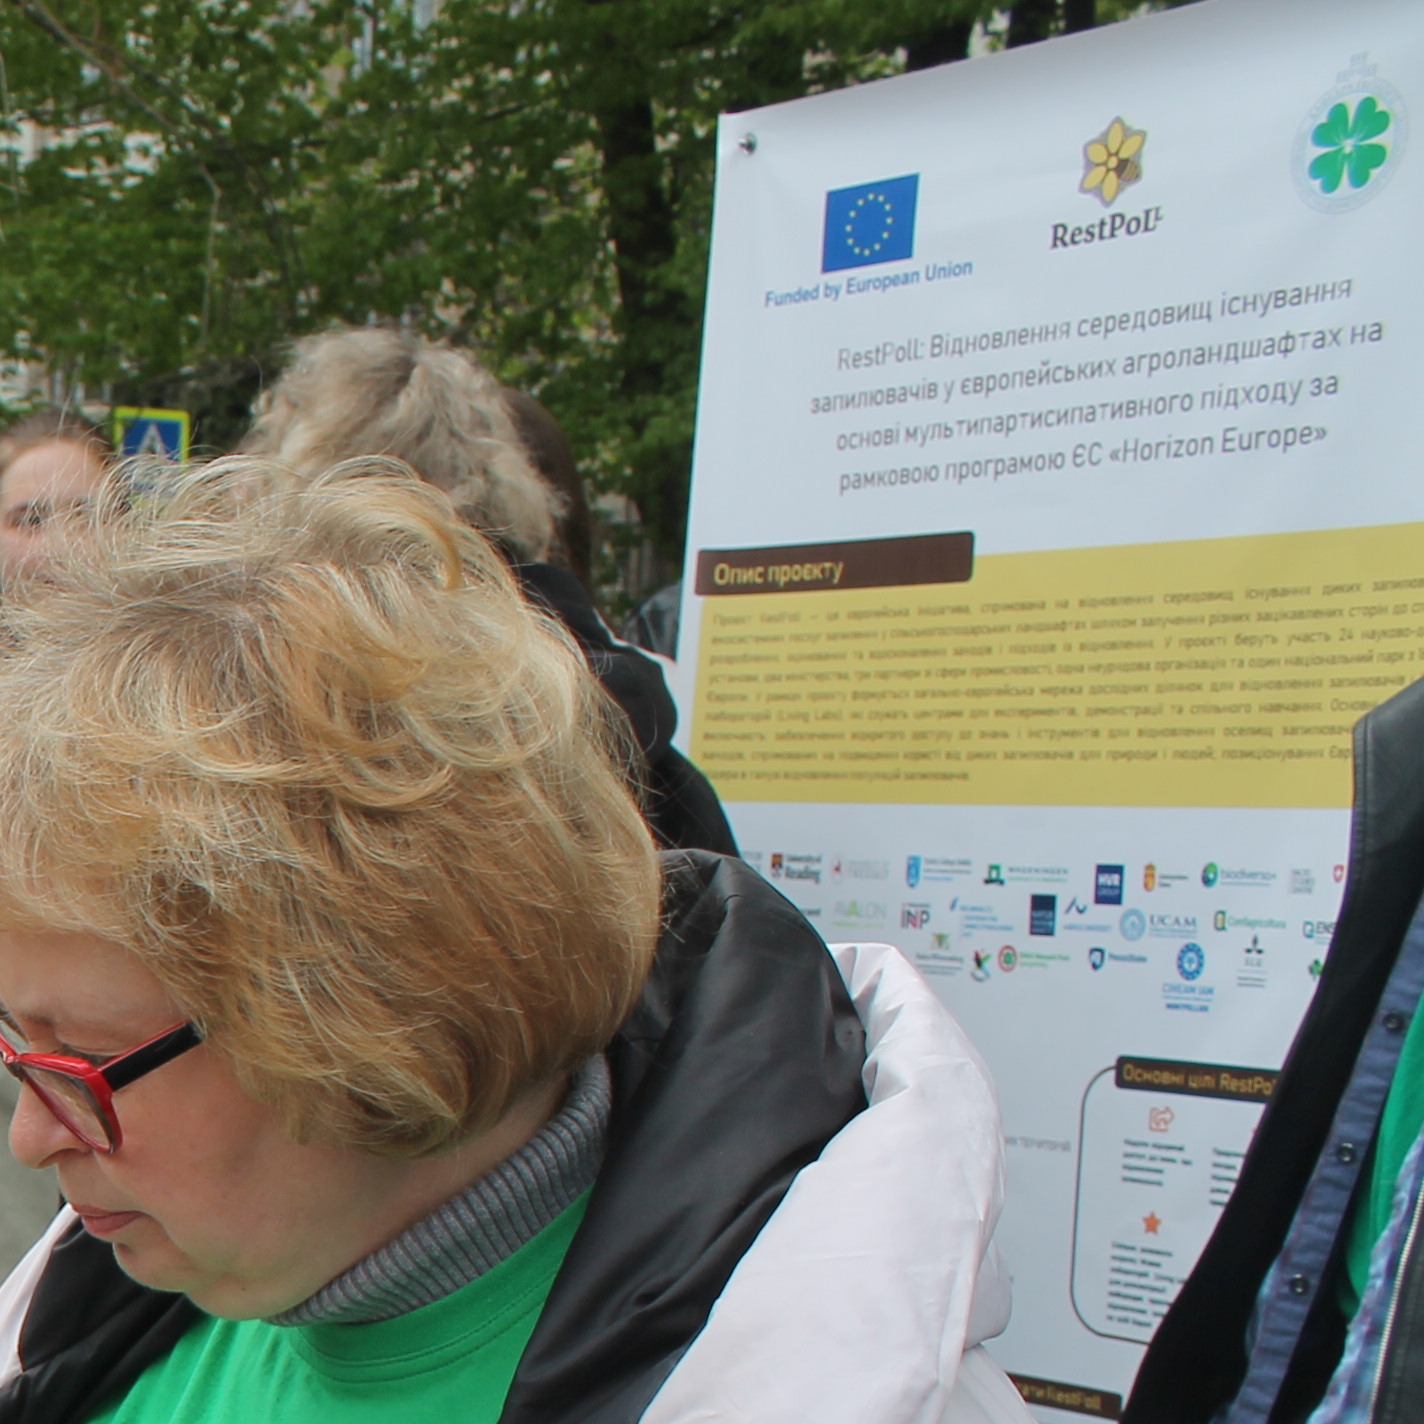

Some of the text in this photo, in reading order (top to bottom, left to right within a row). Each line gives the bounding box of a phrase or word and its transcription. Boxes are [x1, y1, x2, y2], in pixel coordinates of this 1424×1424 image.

[764, 261, 973, 308] Funded by European Union
[837, 278, 1353, 371] RestPoll: Відновлення середовищ існування
[810, 321, 1384, 414] запилювачів у європейських агроландшафтах на
[837, 375, 1339, 451] основі мультипартисипативного підходу за
[839, 424, 1327, 496] рамковою програмою ЄС «Horizon Europe»
[714, 562, 765, 585] Опис
[1150, 914, 1197, 928] UCAM
